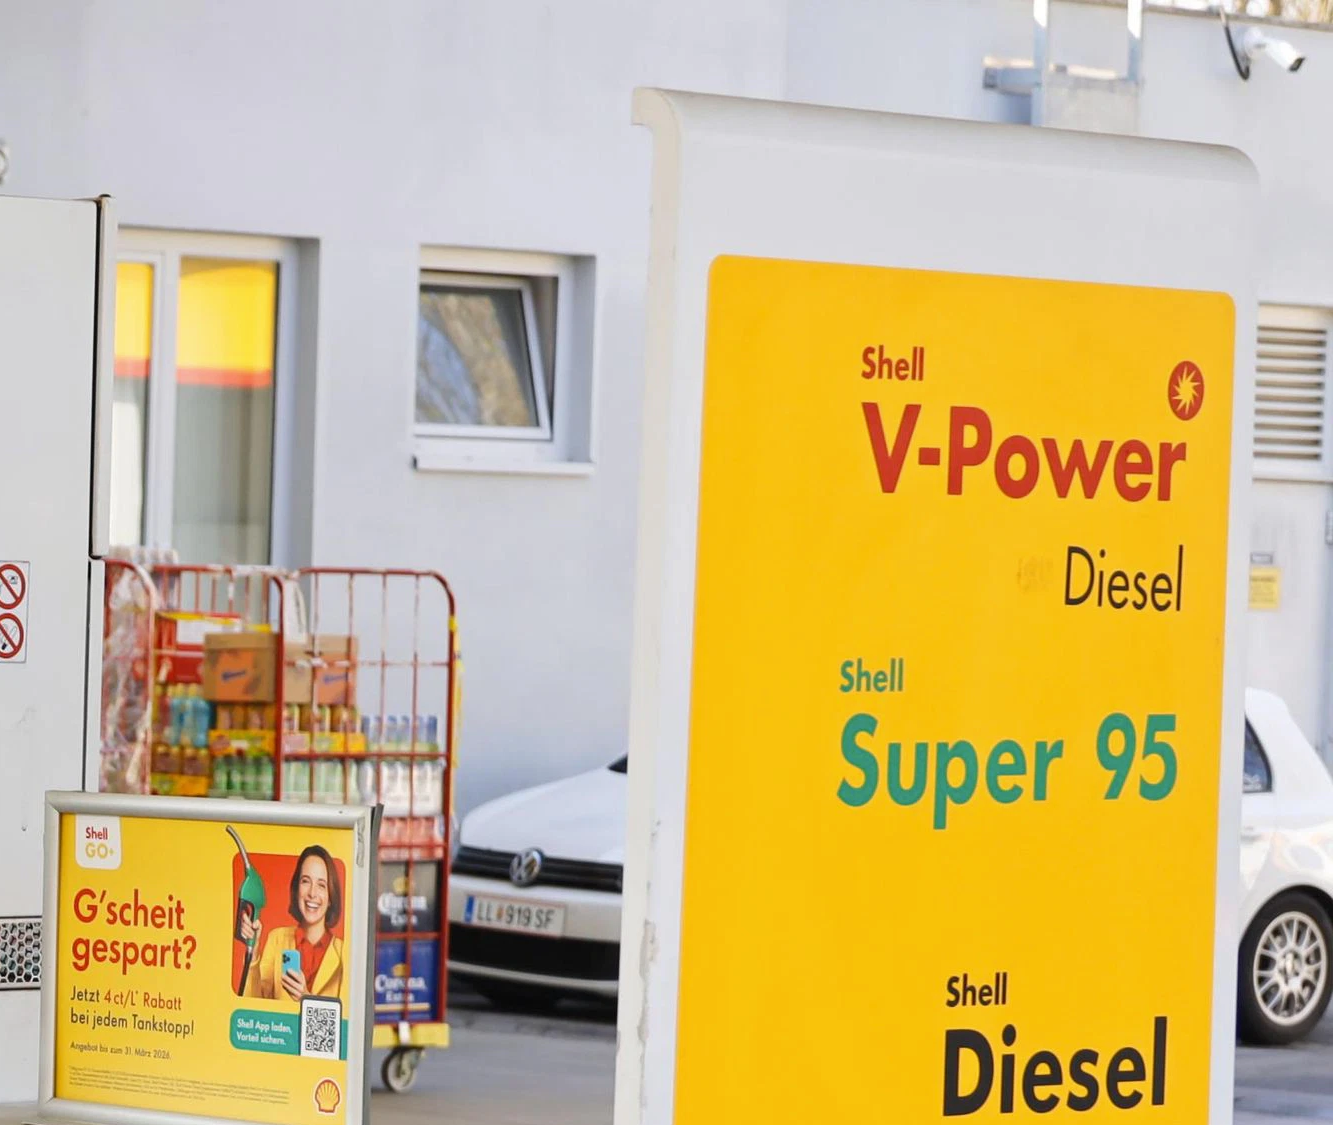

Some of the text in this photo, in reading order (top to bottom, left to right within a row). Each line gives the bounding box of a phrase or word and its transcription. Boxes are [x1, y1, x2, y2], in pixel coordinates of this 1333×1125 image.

[861, 344, 925, 382] Shell
[861, 402, 1187, 502] V-Power
[1064, 544, 1184, 612] Diesel
[839, 657, 904, 692] Shell
[836, 712, 1178, 831] Super 95
[85, 842, 114, 859] GO+
[86, 826, 108, 840] Shell
[73, 888, 185, 931] G'scheit
[477, 901, 555, 929] LL 919 SF
[71, 934, 197, 976] gespart?
[70, 985, 100, 1003] Jetzt
[143, 992, 182, 1011] Rabatt
[945, 972, 1007, 1008] Shell
[71, 1007, 194, 1039] bei jedem Tankstopp!
[237, 1018, 292, 1034] Shell App laden,
[237, 1031, 286, 1045] Vorteil sichern.
[70, 1041, 98, 1053] Angebot
[99, 1043, 108, 1052] bis
[110, 1046, 123, 1055] zum
[134, 1048, 151, 1058] März
[942, 1015, 1168, 1117] Diesel
